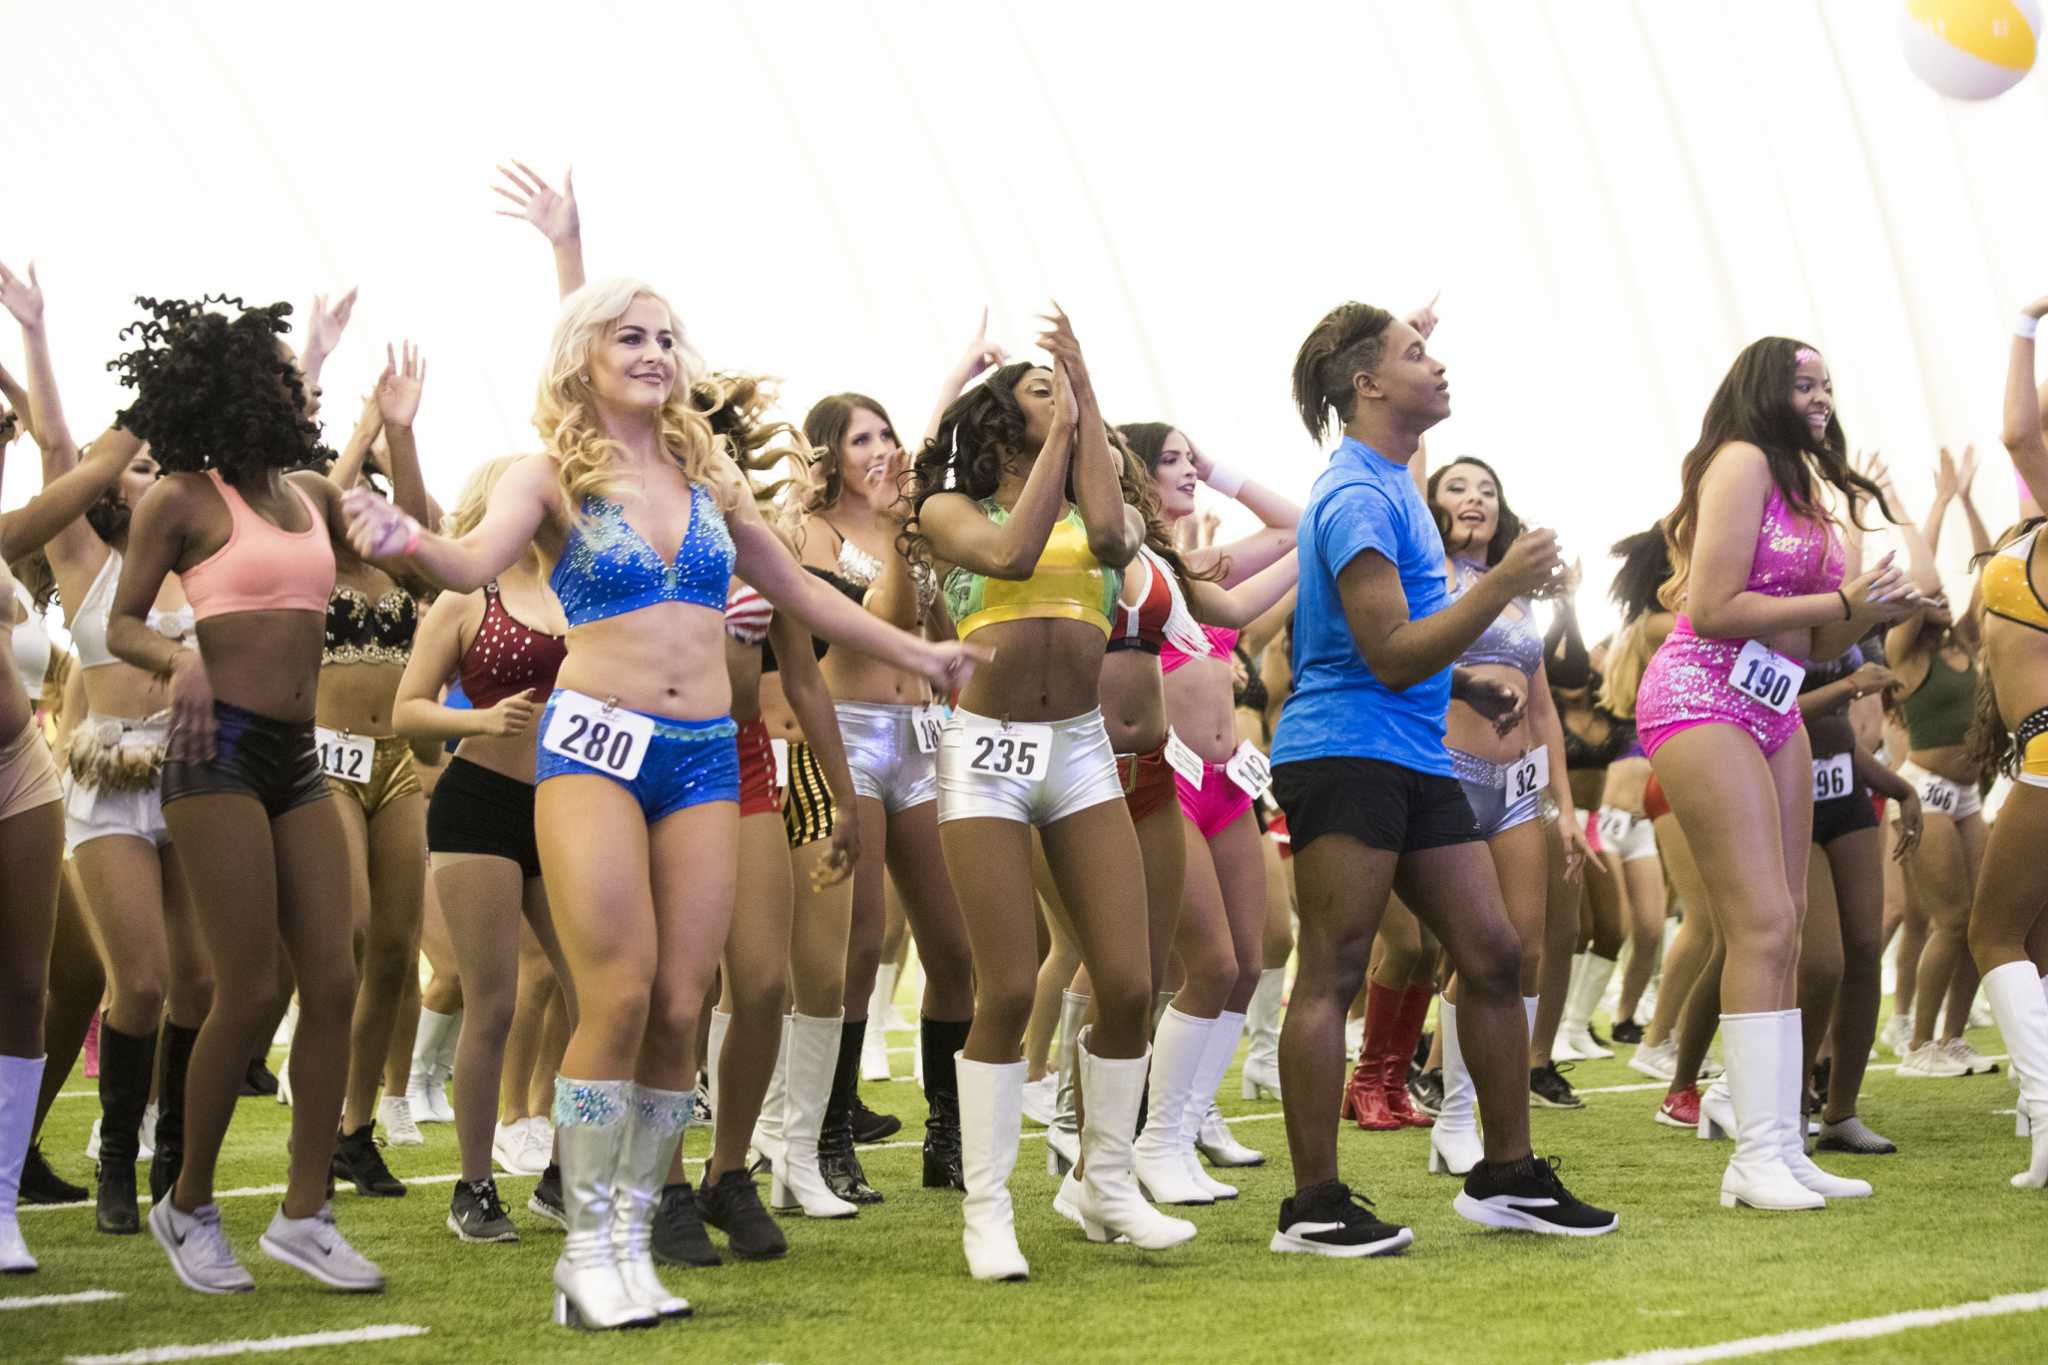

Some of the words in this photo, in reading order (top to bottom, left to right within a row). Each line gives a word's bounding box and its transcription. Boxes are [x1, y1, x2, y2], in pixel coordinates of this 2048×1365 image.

[1740, 658, 1791, 707] 190
[319, 742, 364, 779] 112
[559, 713, 633, 771] 280
[971, 736, 1038, 775] 235
[1516, 763, 1537, 798] 32
[1920, 783, 1954, 810] 306
